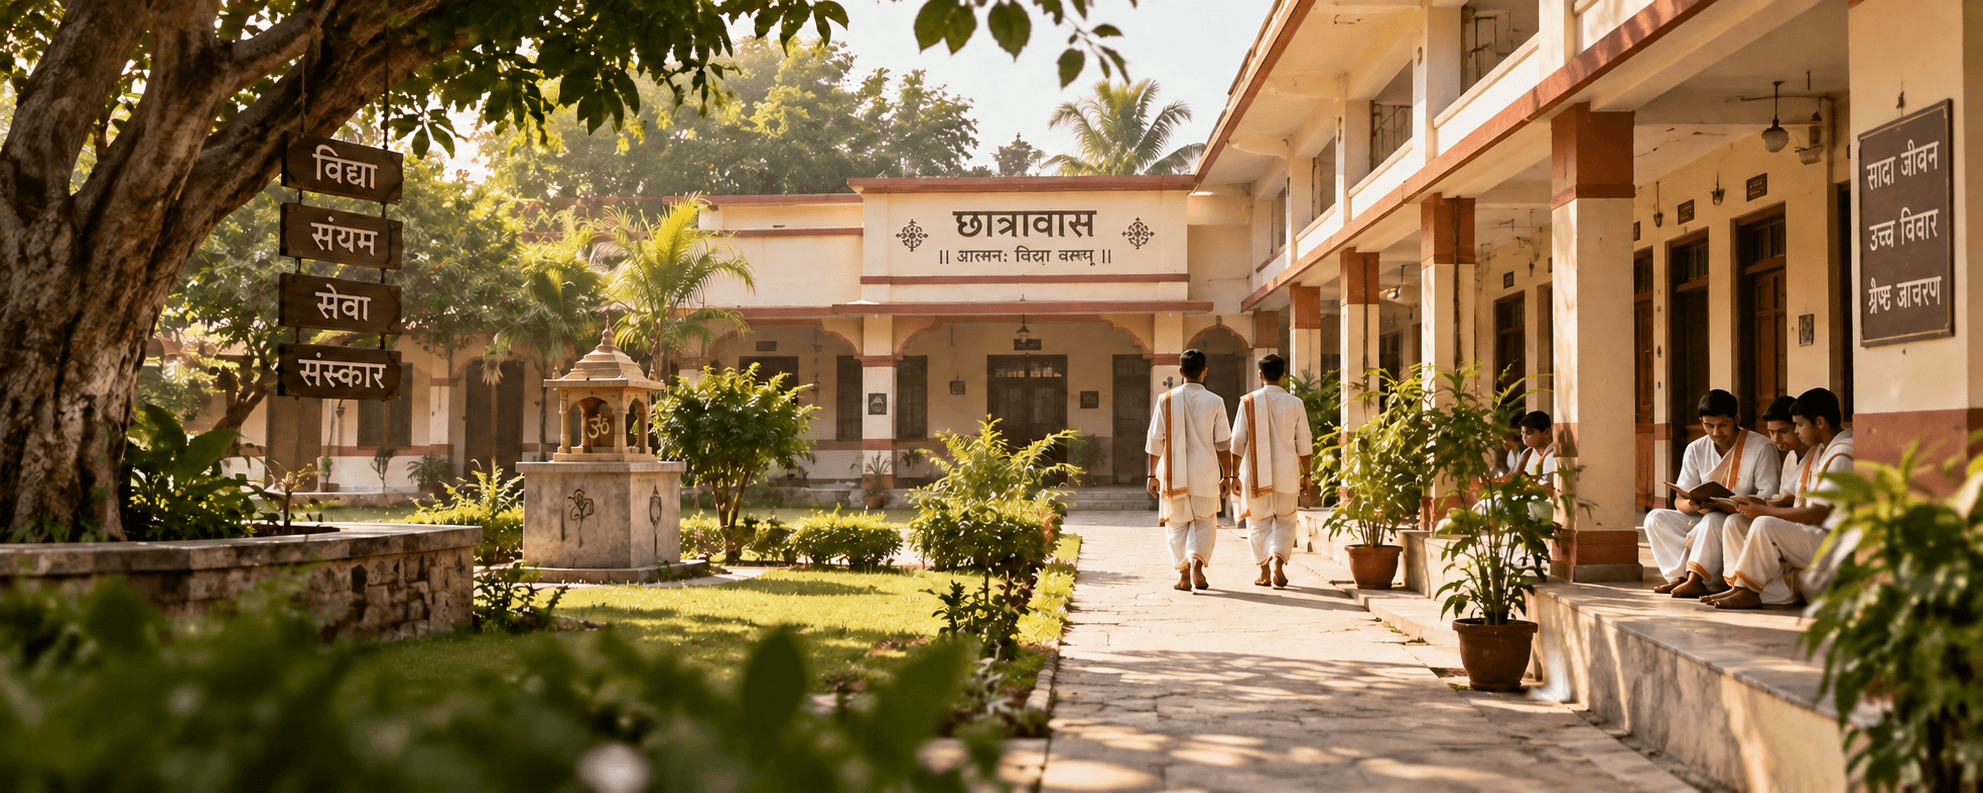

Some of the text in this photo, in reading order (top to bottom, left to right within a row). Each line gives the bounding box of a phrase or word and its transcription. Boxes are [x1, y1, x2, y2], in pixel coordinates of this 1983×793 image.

[312, 144, 378, 190] विद्या
[1866, 139, 1939, 190] सादा जीवन
[310, 216, 378, 256] संयम
[952, 210, 1097, 238] छात्रावास
[315, 283, 371, 321] सेवा
[298, 352, 387, 389] संस्कार
